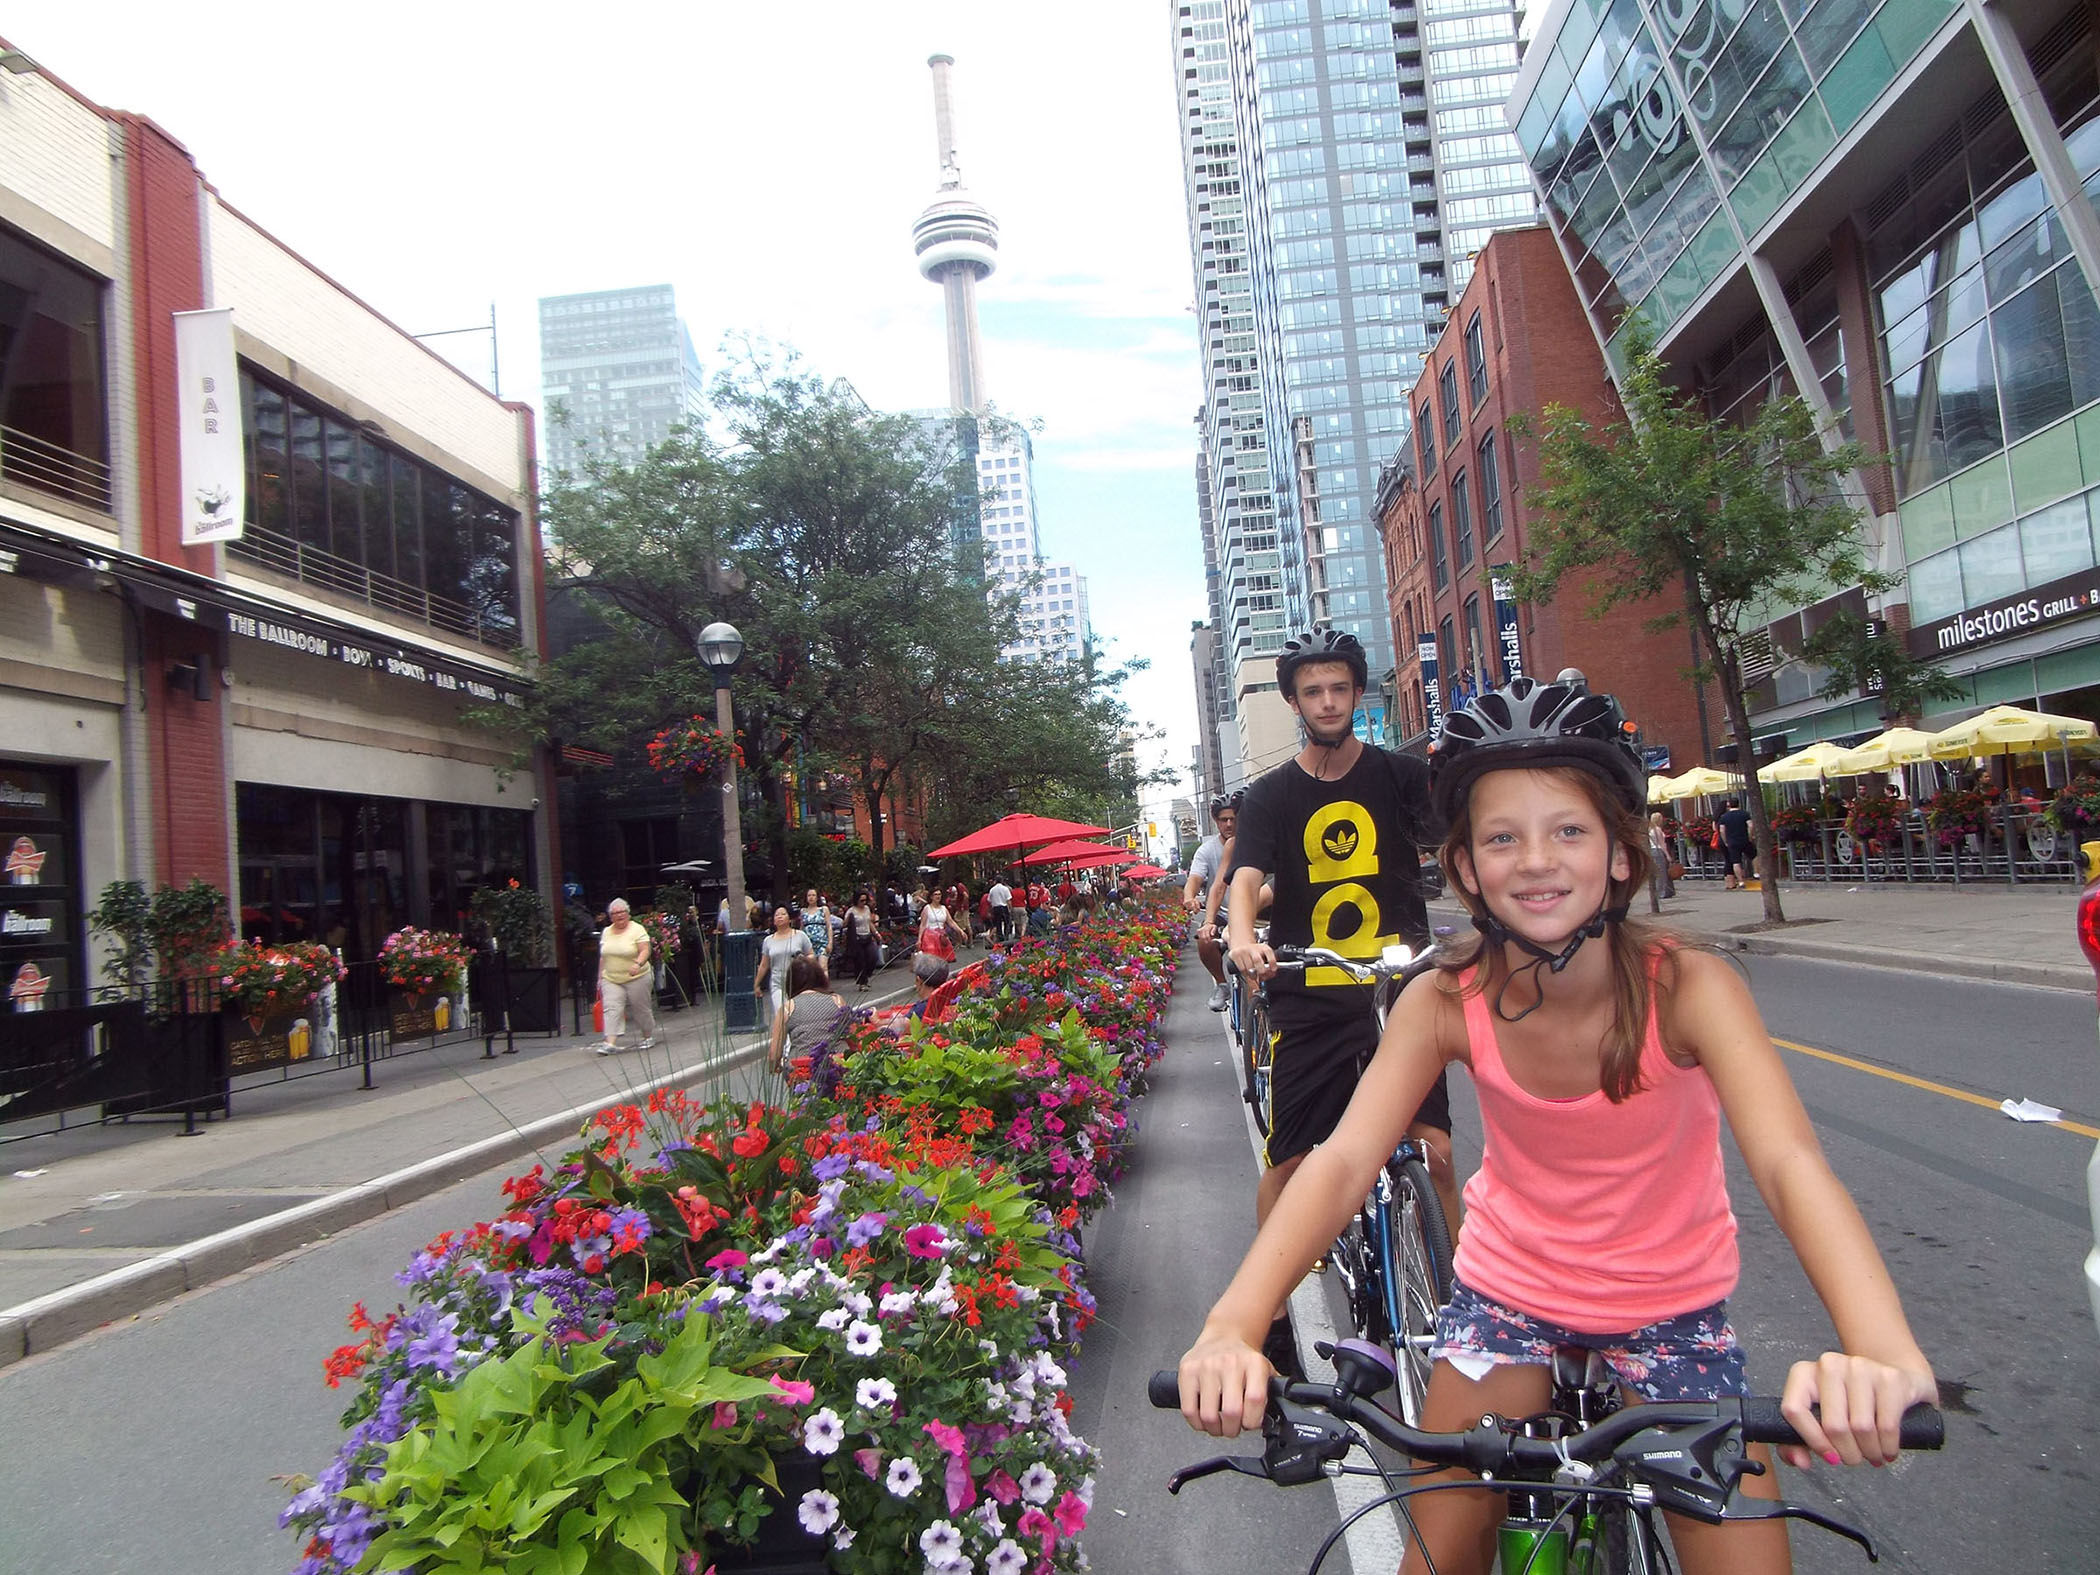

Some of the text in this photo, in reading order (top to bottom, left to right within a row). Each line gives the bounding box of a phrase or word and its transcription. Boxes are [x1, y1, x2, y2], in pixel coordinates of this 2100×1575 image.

[202, 377, 219, 434] BAR
[1938, 589, 2100, 649] milestones GRILL B
[228, 613, 256, 637] THE
[259, 622, 327, 656] BALLROOM
[387, 658, 425, 681] SPORTS
[436, 672, 457, 690] BAR
[467, 681, 496, 700] GAMES
[1501, 623, 1522, 681] arshalls
[1424, 679, 1443, 741] Marshalls
[567, 886, 577, 896] 7
[1293, 1423, 1322, 1434] SHIMANO
[1643, 1450, 1683, 1460] SHIMANO
